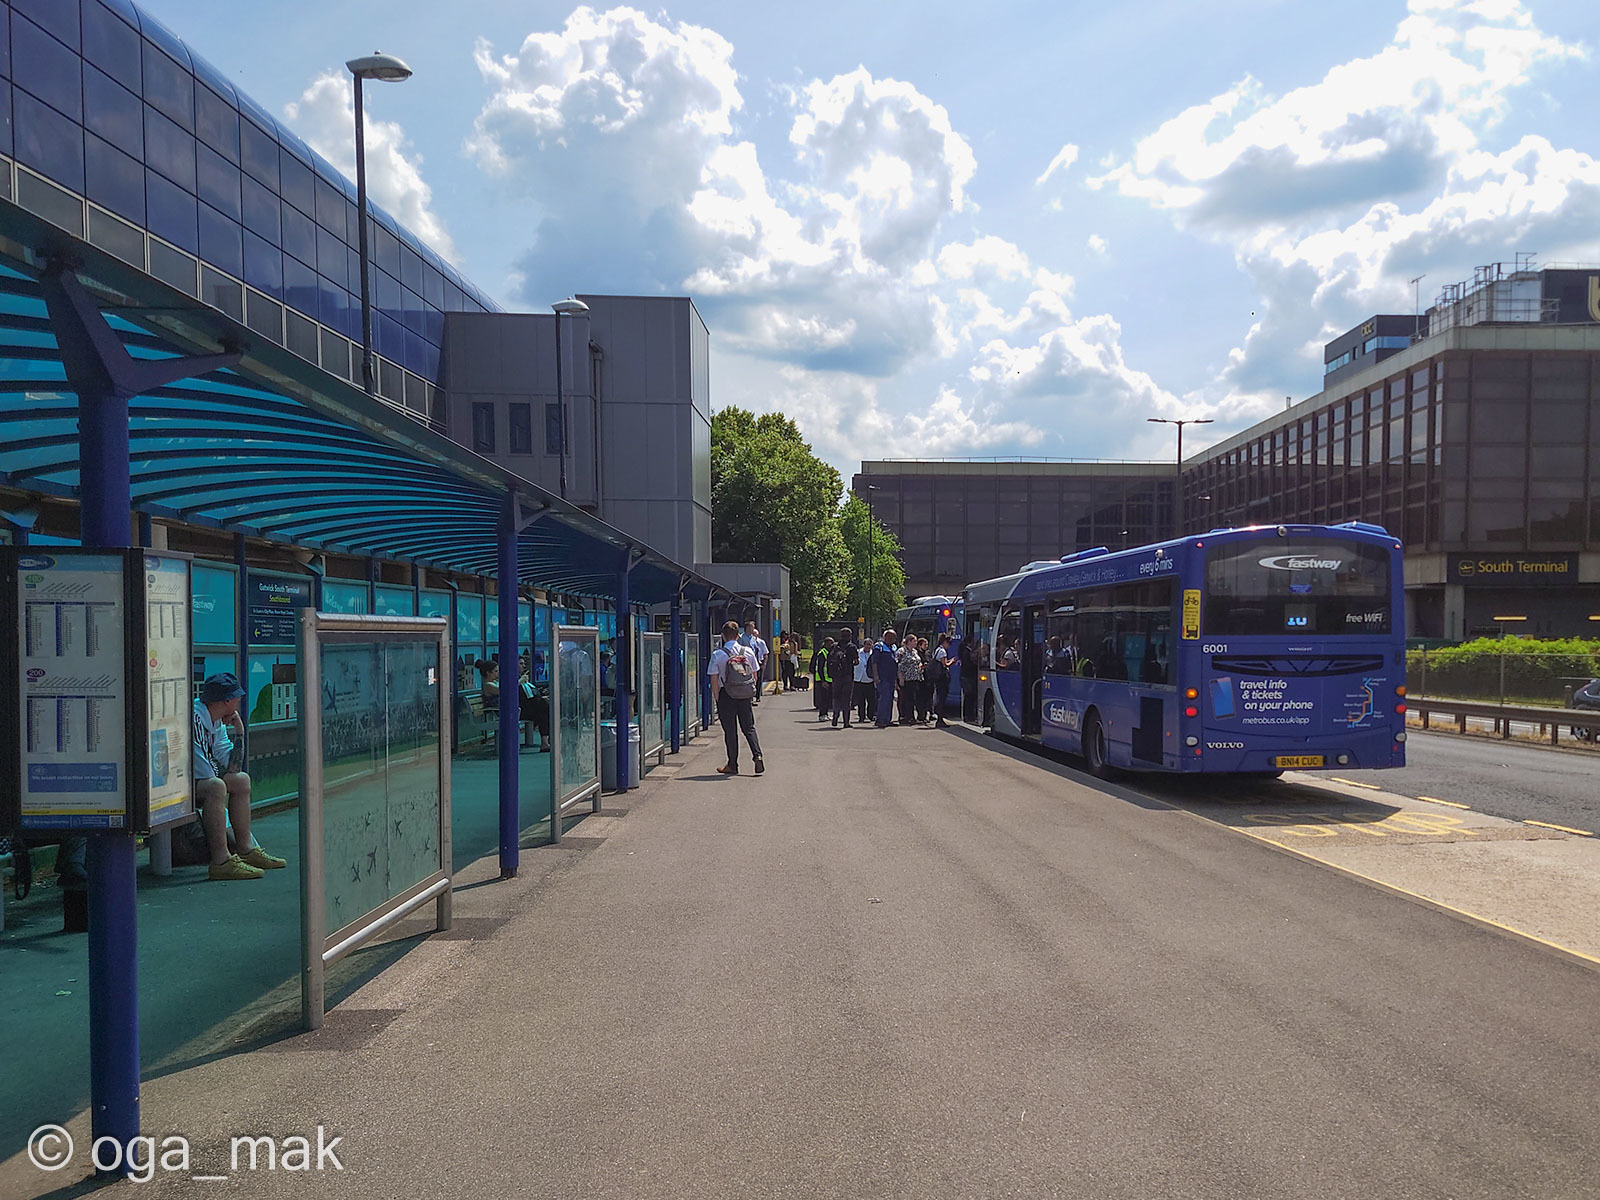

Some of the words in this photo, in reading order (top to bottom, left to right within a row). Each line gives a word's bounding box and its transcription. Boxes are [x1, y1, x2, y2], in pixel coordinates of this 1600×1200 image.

[1139, 562, 1154, 575] every
[1160, 556, 1173, 571] mins
[1287, 558, 1342, 571] fastway
[1478, 560, 1513, 573] South
[1516, 560, 1568, 573] Terminal
[1345, 613, 1363, 622] free
[1364, 613, 1383, 622] WiFi
[1202, 644, 1228, 653] 6001
[28, 669, 44, 677] 200
[1240, 680, 1267, 689] travel
[1268, 680, 1287, 689] info
[1241, 689, 1250, 699] &
[1251, 689, 1283, 699] tickets
[1244, 702, 1257, 710] on
[1258, 702, 1282, 712] your
[1282, 700, 1313, 711] phone
[1050, 703, 1081, 729] fastway
